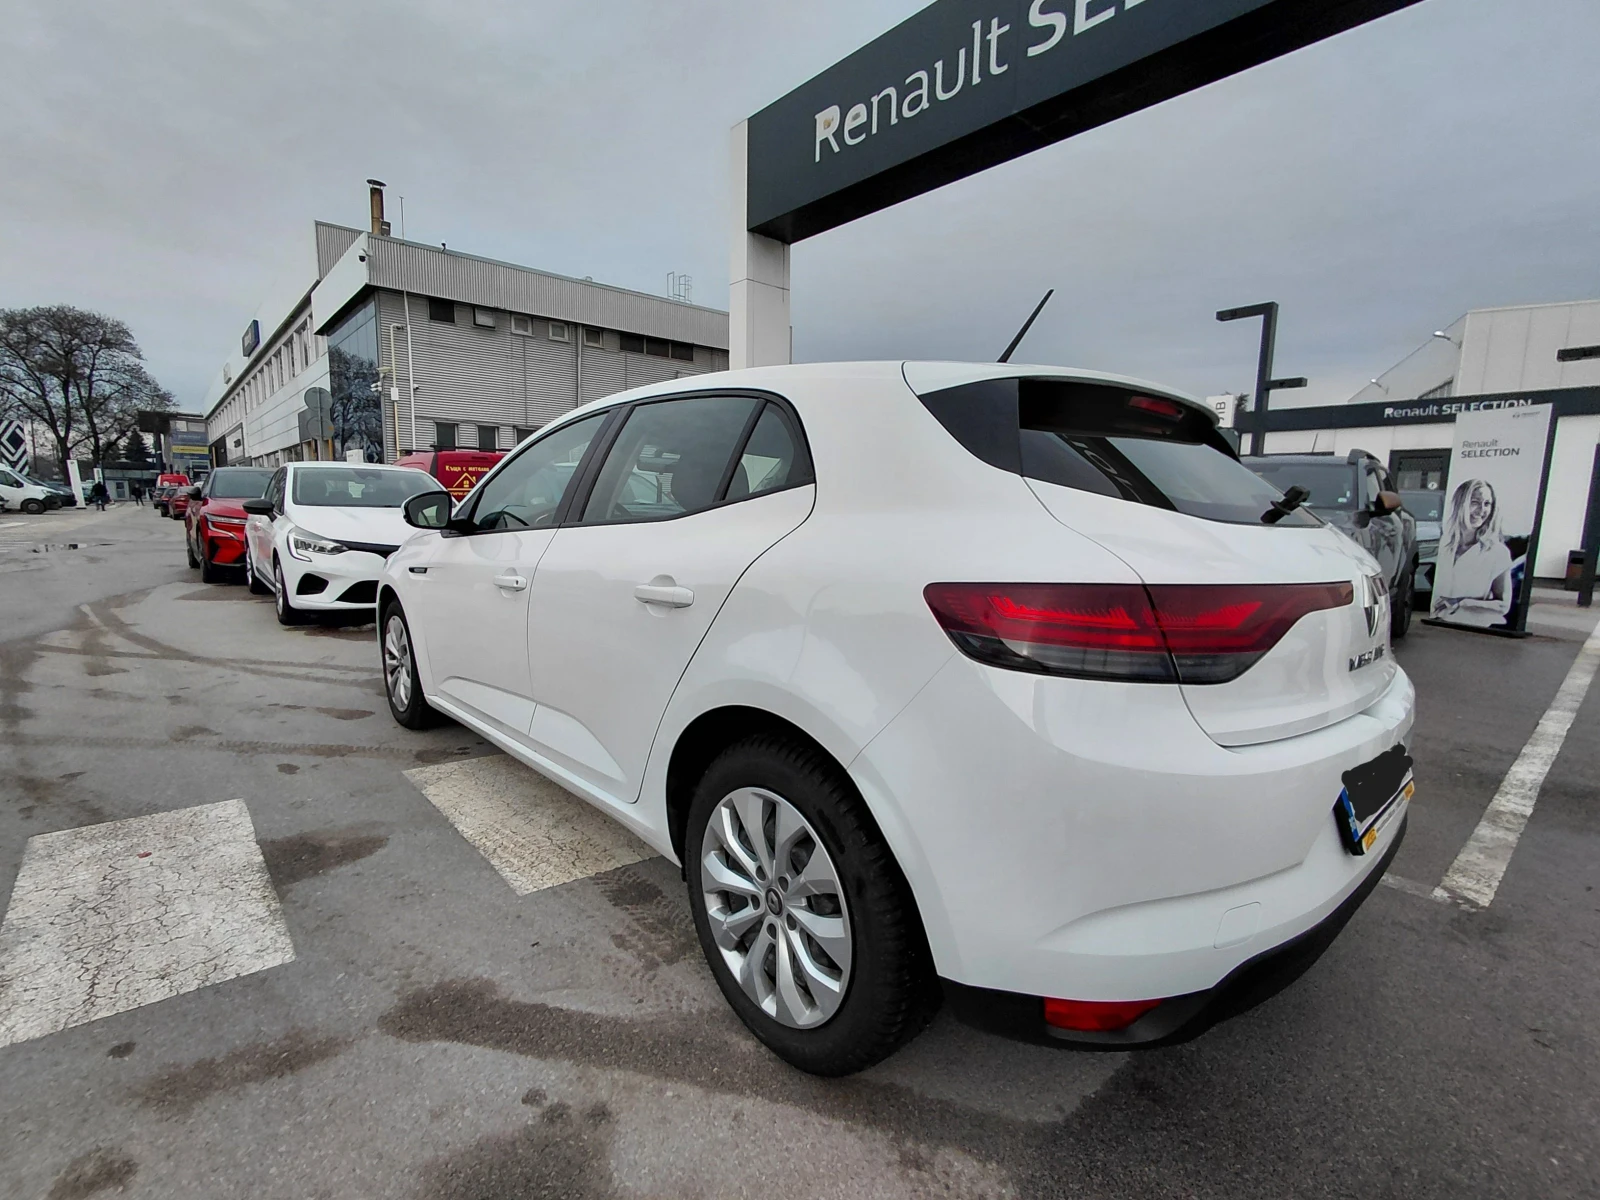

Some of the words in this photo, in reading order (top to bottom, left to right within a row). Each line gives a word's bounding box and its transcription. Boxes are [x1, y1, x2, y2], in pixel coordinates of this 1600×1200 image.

[814, 17, 1010, 163] Renault
[1384, 405, 1439, 418] Renault
[1462, 439, 1499, 449] Renault
[1461, 447, 1520, 458] SELECTION
